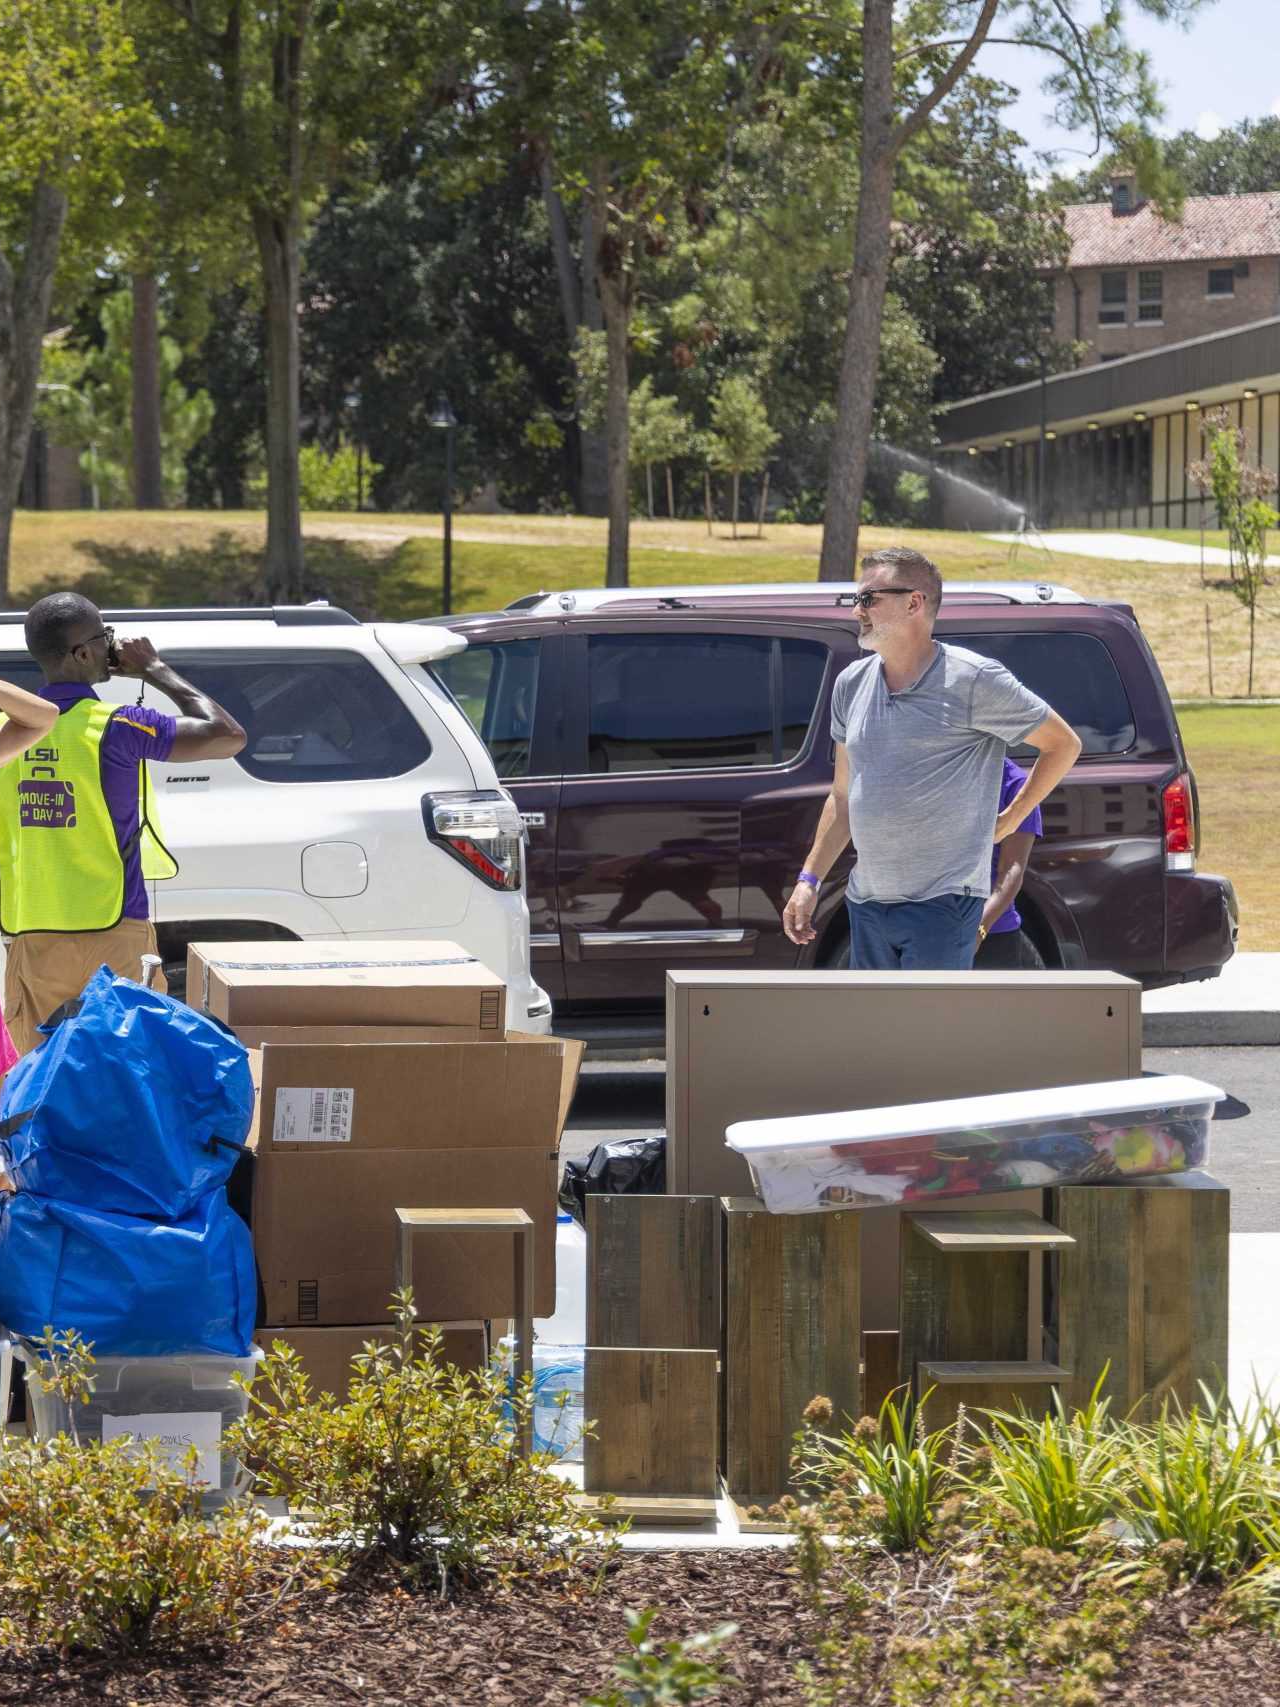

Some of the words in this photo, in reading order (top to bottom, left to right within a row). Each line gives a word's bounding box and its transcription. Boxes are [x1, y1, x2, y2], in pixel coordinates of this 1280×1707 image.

[24, 748, 60, 762] LSU
[19, 792, 65, 807] MOVE-IN
[32, 808, 54, 822] DAY
